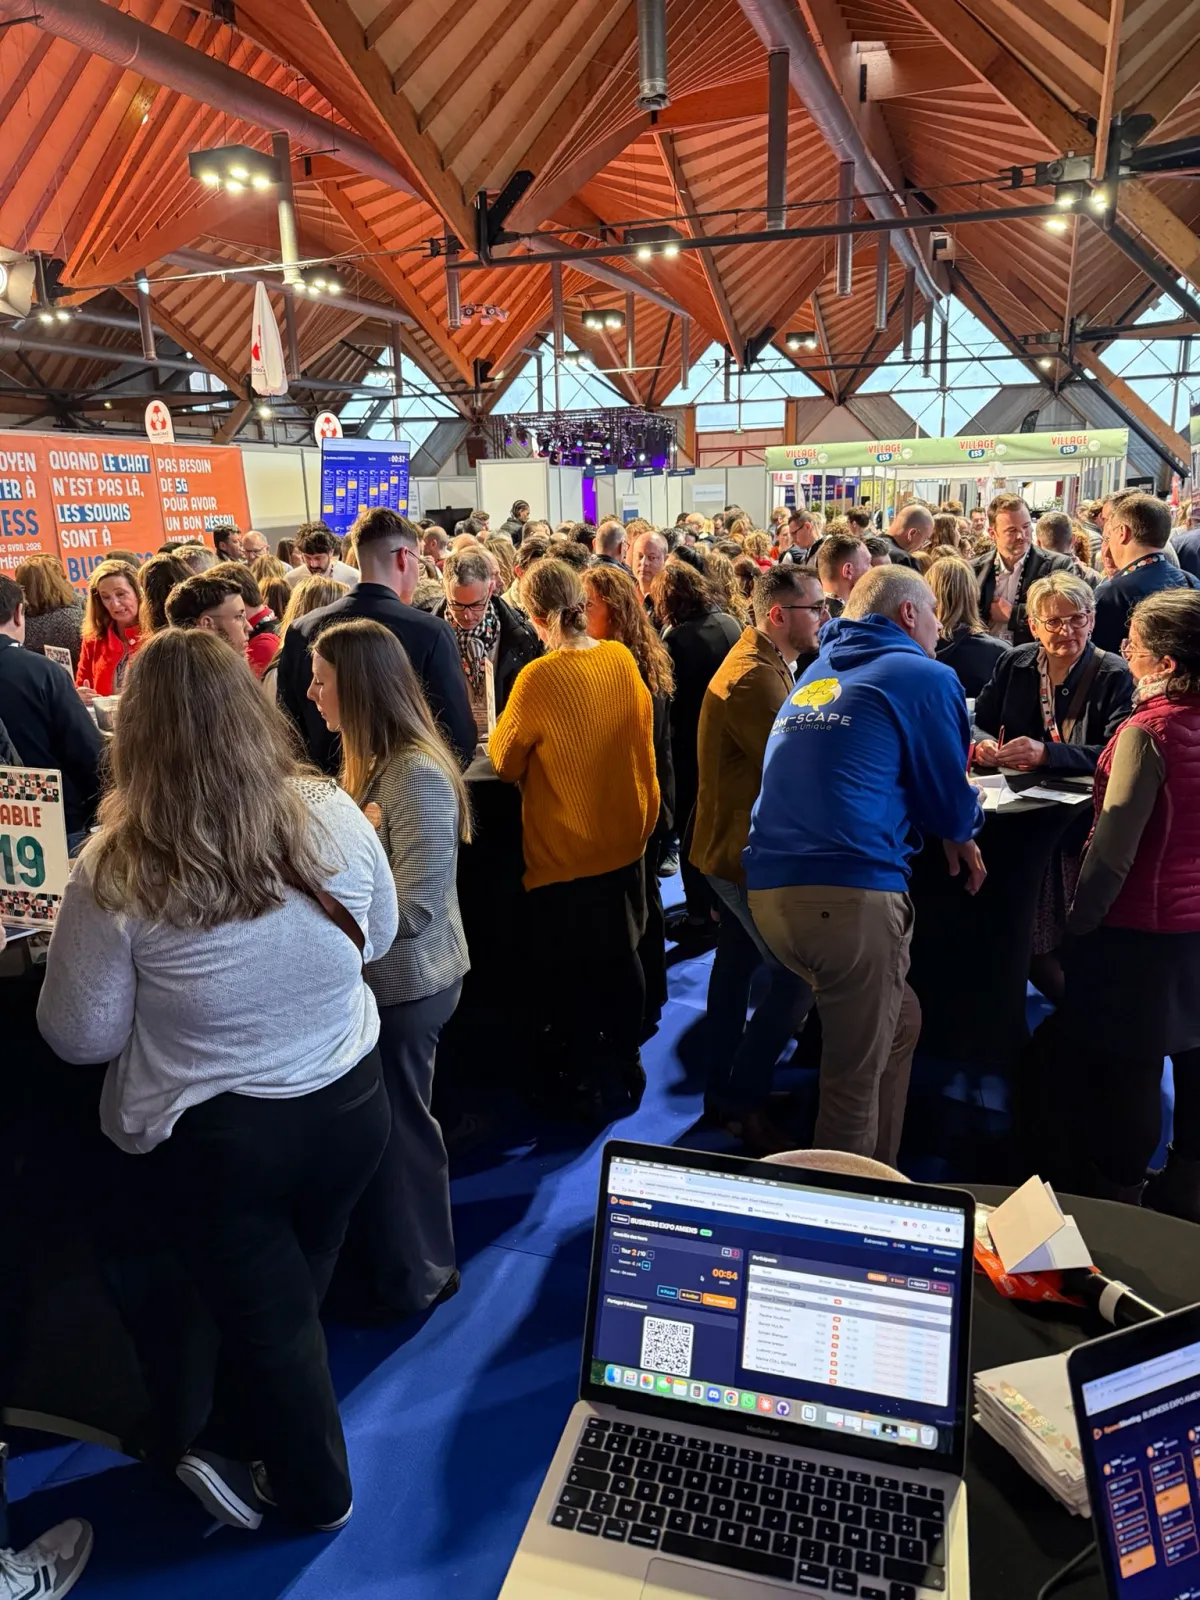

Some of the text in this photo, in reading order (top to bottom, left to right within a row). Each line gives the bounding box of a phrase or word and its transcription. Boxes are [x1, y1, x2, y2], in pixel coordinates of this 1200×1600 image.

[959, 440, 995, 449] VILLAGE
[1051, 436, 1088, 446] VILLAGE
[785, 448, 817, 458] VILLAGE
[868, 444, 901, 454] VILLAGE
[49, 450, 150, 472] QUAND LE CHAT
[157, 458, 212, 473] PAS BESOIN
[25, 475, 37, 498] À
[52, 475, 145, 498] N'EST PAS LÀ,
[160, 477, 188, 493] DE 5G
[163, 496, 218, 512] POUR AVOIR
[56, 503, 131, 523] LES SOURIS
[0, 509, 39, 536] ESS
[165, 516, 181, 531] UN
[183, 515, 202, 530] BON
[61, 525, 112, 548] SONT À
[7, 543, 25, 553] AVRIL
[26, 542, 42, 552] 2026
[781, 725, 797, 733] Com
[800, 723, 832, 731] Unique
[0, 834, 46, 888] 19
[630, 1217, 659, 1228] BUSINESS
[659, 1221, 675, 1231] EXPO
[712, 1268, 738, 1280] 00:54
[1142, 1403, 1170, 1420] BUSINESS
[1168, 1397, 1185, 1410] EXPO
[668, 1492, 675, 1500] D
[728, 1528, 735, 1536] B
